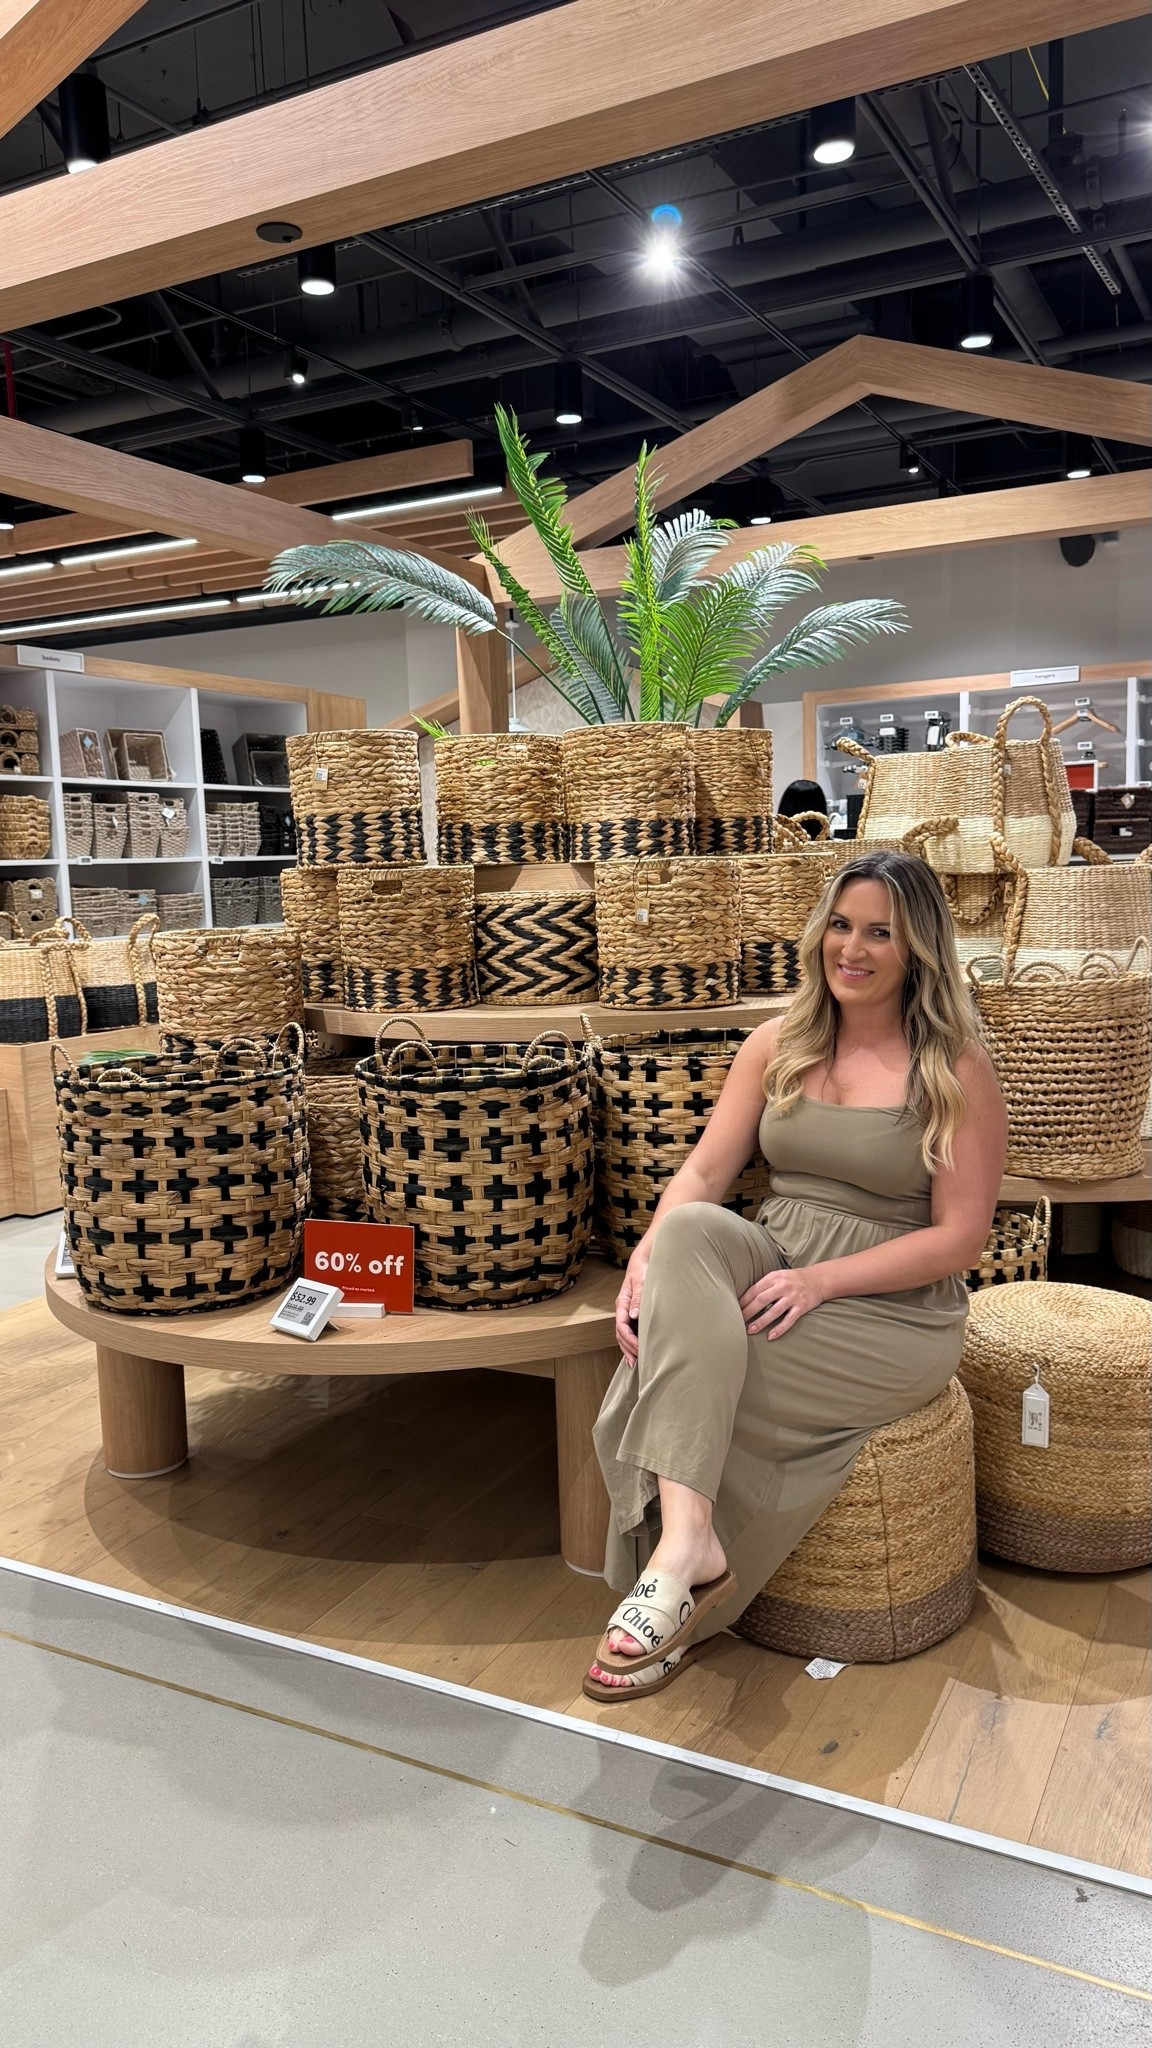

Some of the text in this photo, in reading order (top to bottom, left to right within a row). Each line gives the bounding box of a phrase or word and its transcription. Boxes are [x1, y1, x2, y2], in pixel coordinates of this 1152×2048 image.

[314, 1251, 405, 1276] 60% off
[290, 1291, 317, 1306] $52.99
[622, 1606, 664, 1648] Chloé
